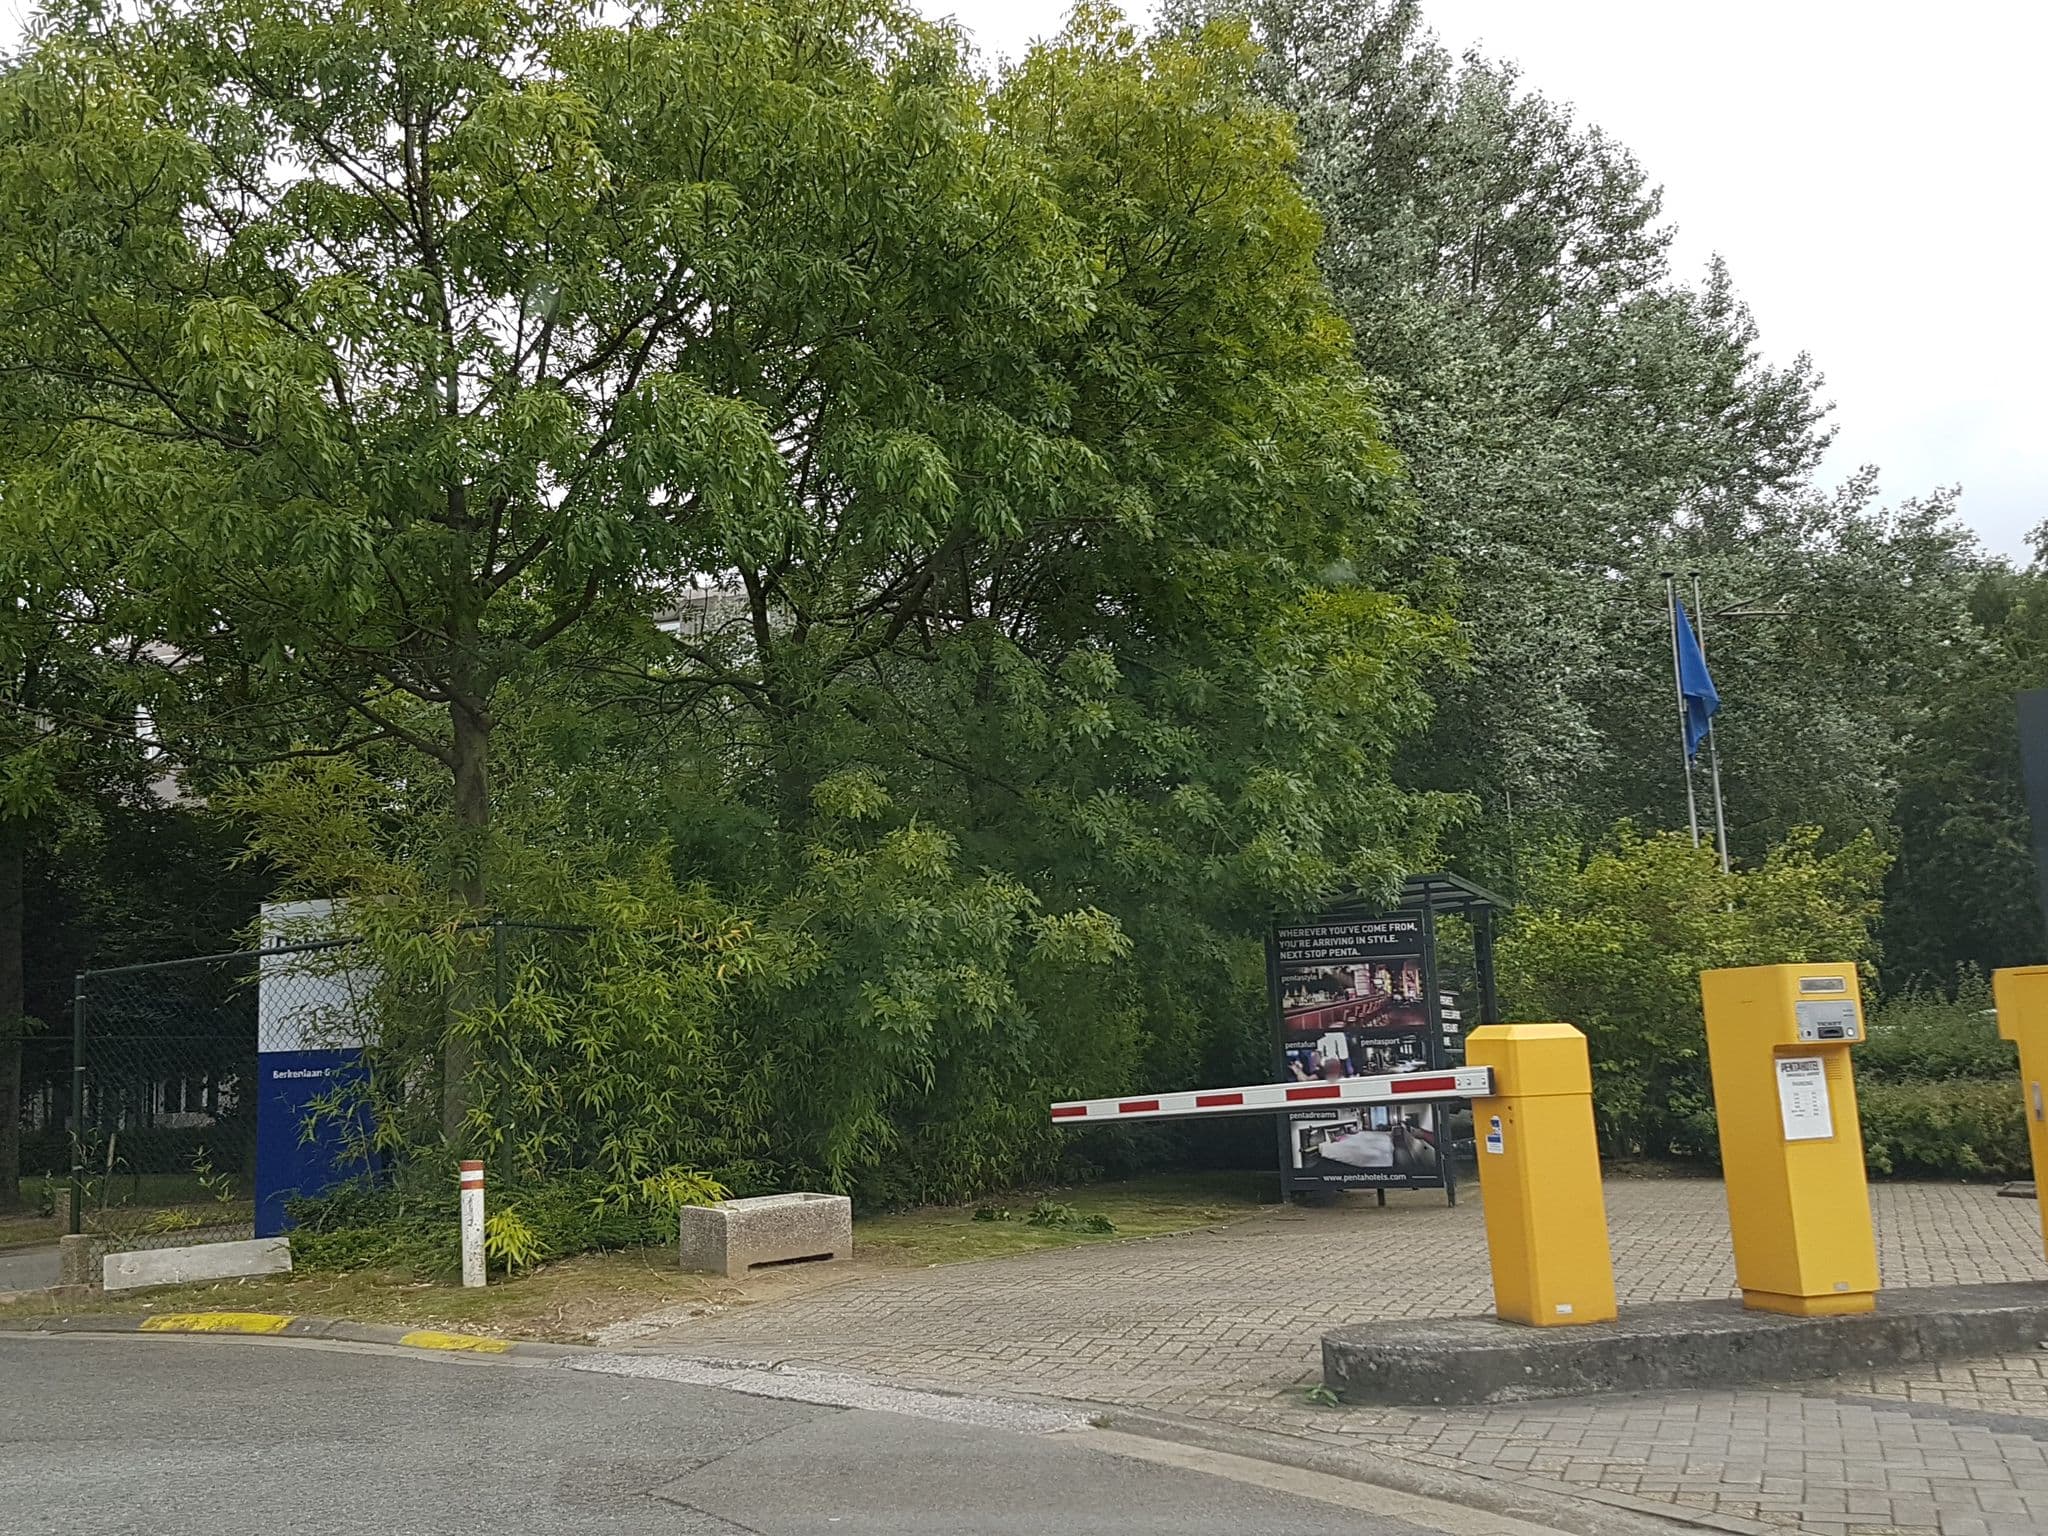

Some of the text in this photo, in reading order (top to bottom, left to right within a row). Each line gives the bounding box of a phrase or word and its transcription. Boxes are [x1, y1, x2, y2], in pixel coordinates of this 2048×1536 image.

[1278, 927, 1327, 938] WHEREVER
[1329, 925, 1360, 935] YOU'VE
[1361, 923, 1388, 933] COME
[1279, 934, 1399, 949] YOU'RE ARRIVING IN STYLE.
[1280, 948, 1361, 960] NEXT STOP PENTA.
[1284, 1040, 1316, 1050] pentafun
[1360, 1037, 1401, 1047] pentasport
[273, 1069, 322, 1079] Berkenlaan
[1289, 1111, 1336, 1120] pentadreams
[1323, 1173, 1407, 1182] www.pentahotels.com
